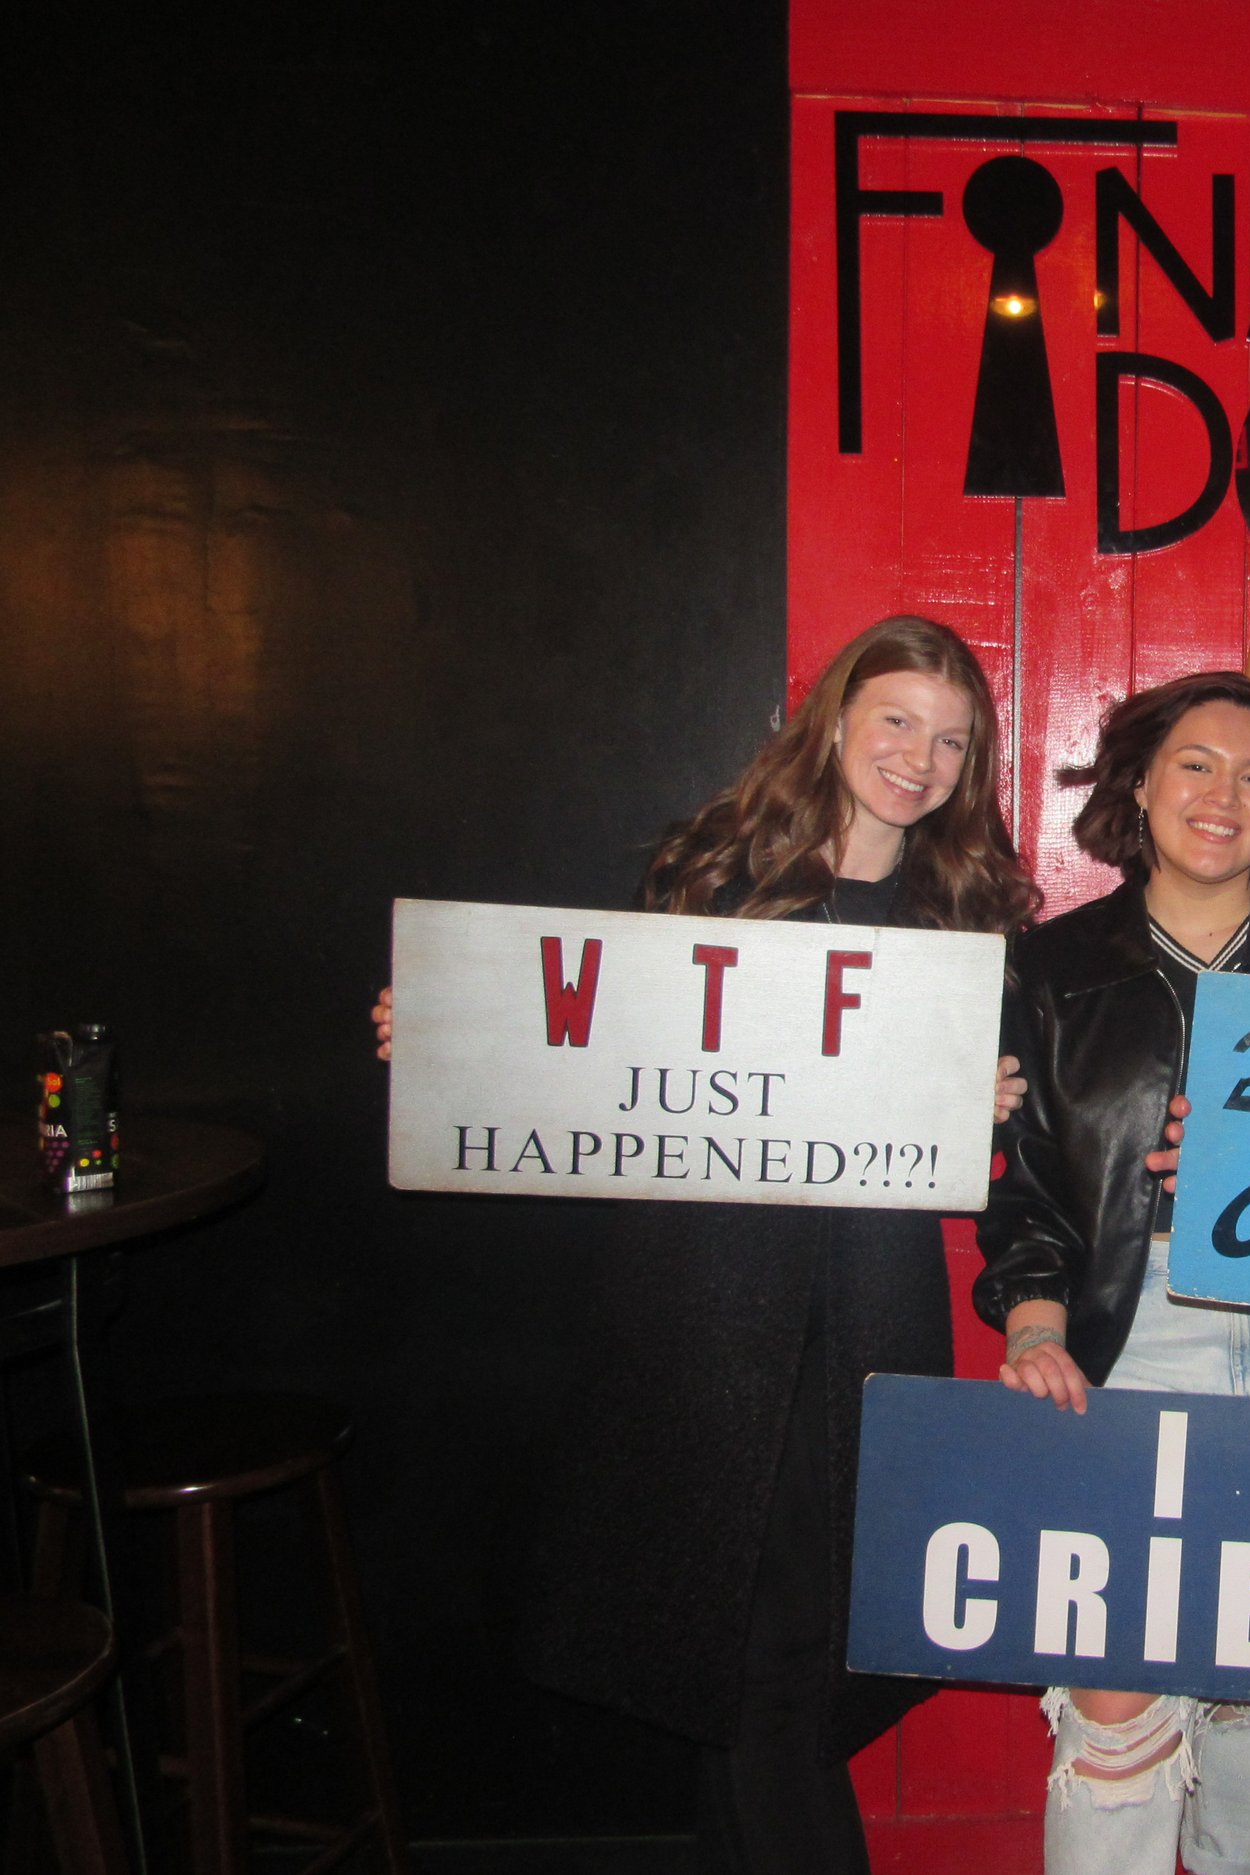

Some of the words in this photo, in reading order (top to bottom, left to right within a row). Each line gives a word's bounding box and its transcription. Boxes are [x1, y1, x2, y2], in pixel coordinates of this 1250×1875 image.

[618, 1066, 787, 1117] JUST
[452, 1125, 939, 1189] HAPPENED?!?!
[1153, 1410, 1189, 1519] I
